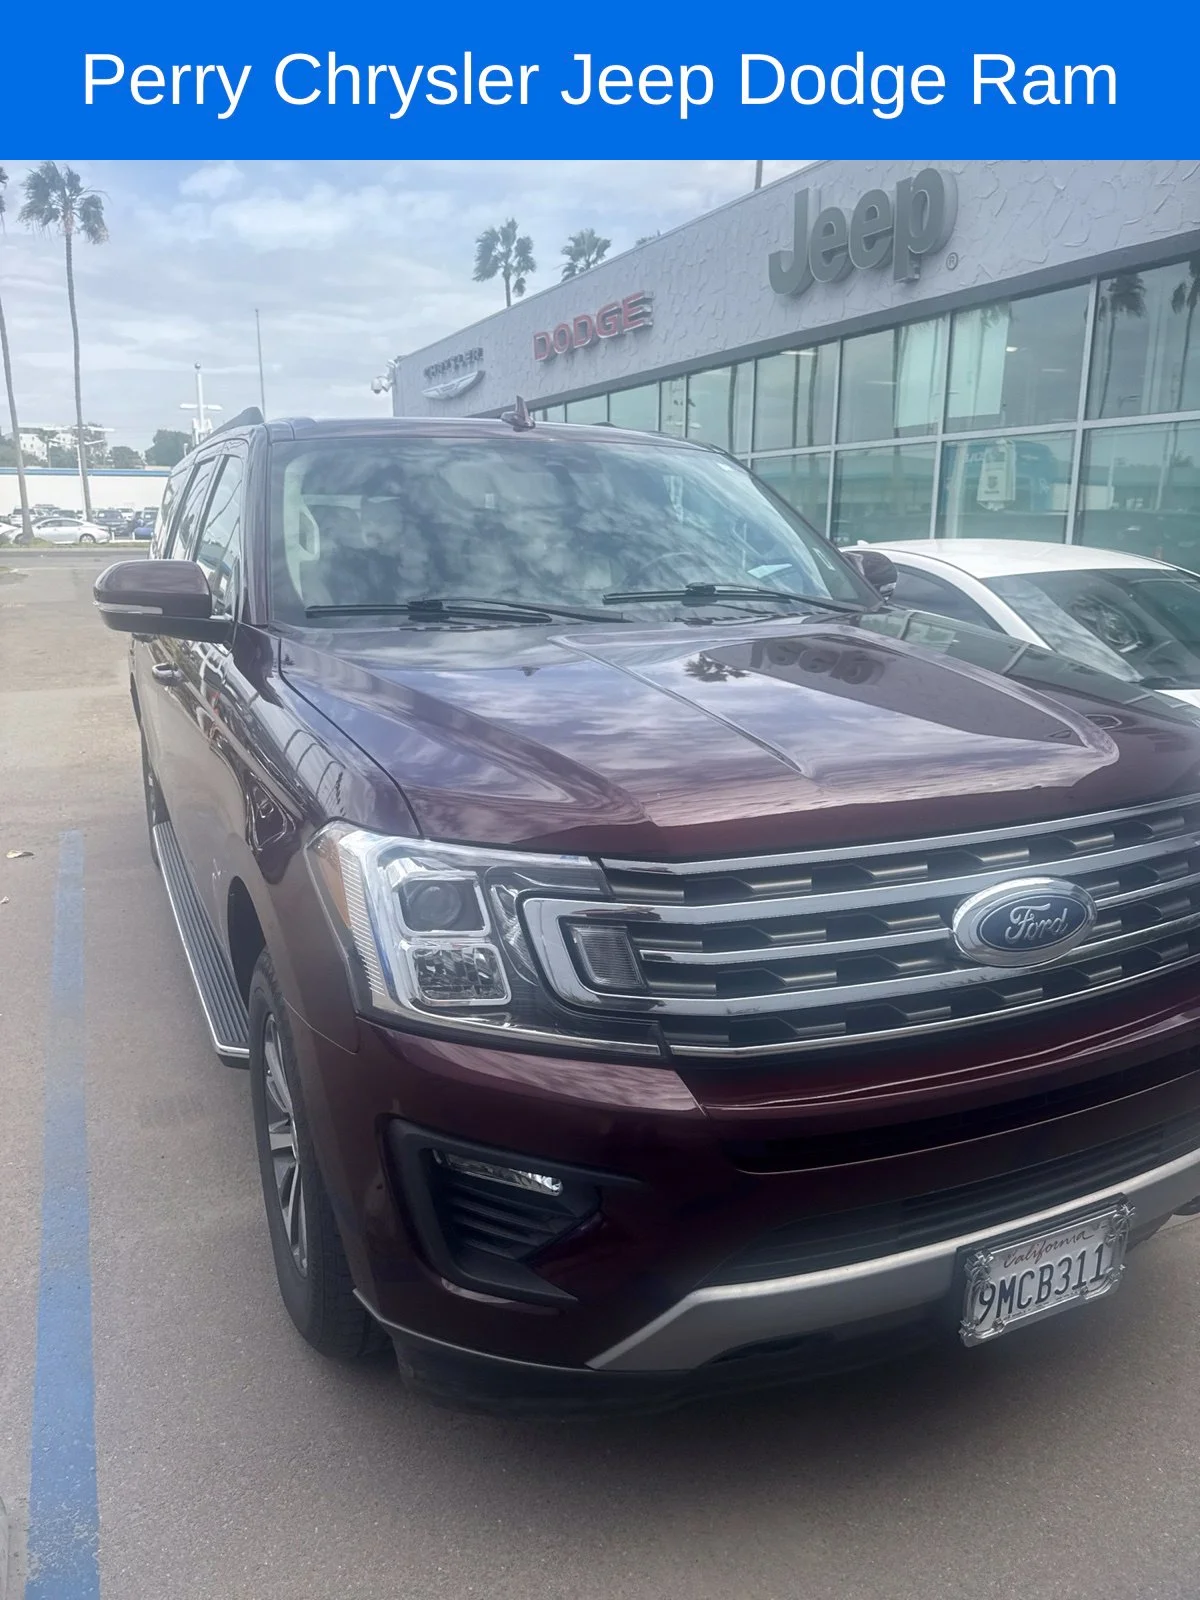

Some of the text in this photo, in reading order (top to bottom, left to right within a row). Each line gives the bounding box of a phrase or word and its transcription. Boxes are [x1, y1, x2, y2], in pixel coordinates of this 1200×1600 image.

[768, 168, 957, 295] Jeep
[533, 291, 653, 361] DODGE
[1005, 903, 1067, 943] Ford
[978, 1242, 1106, 1325] 9MCB311
[1003, 1230, 1094, 1269] California
